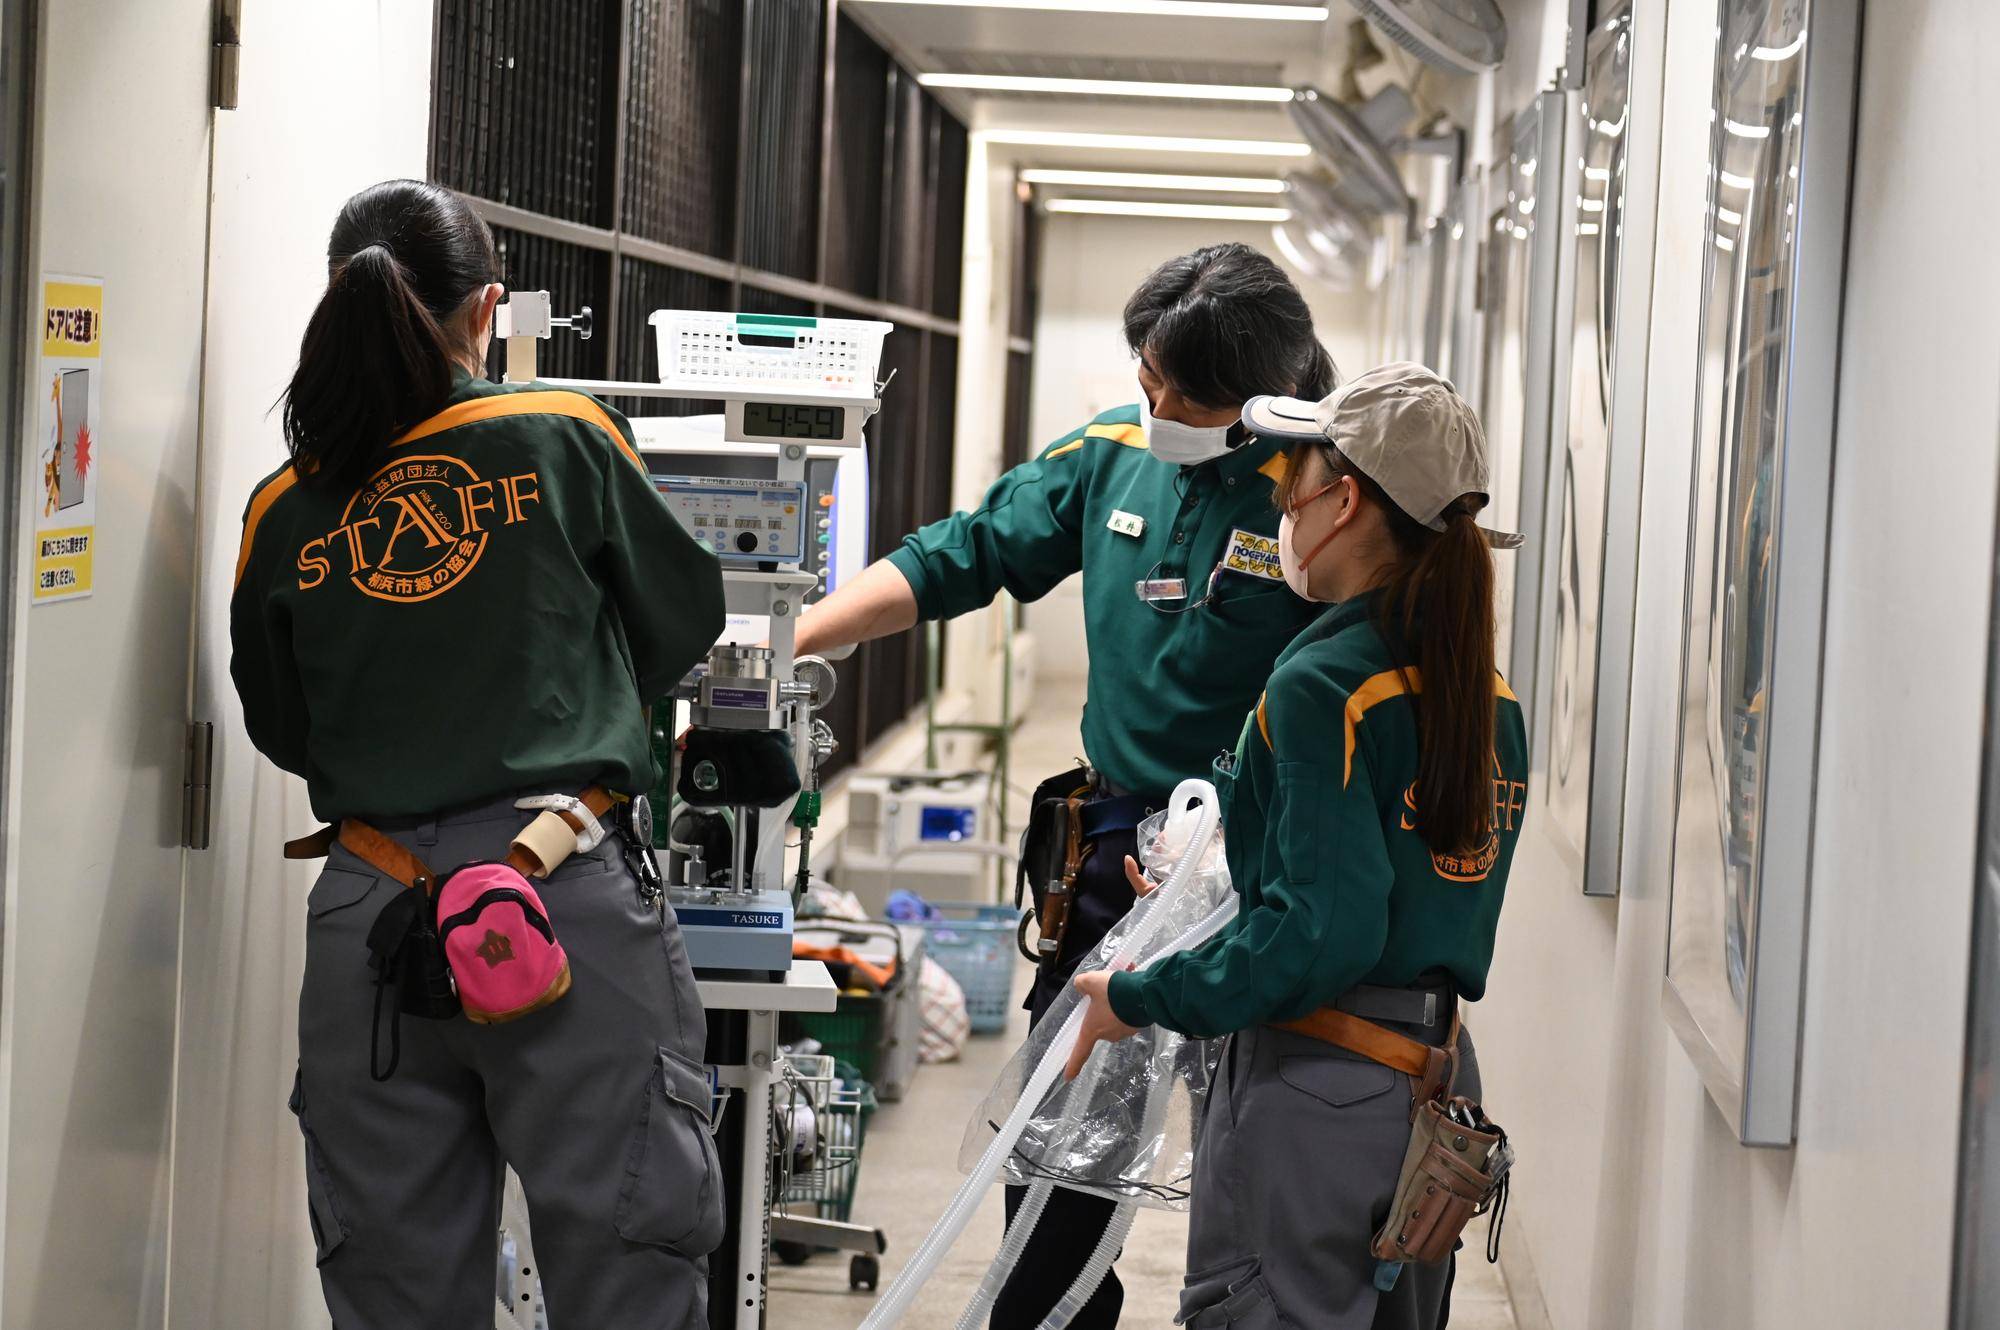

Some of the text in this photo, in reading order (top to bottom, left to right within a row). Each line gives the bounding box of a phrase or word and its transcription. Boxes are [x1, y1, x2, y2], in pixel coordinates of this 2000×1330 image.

[46, 307, 98, 343] ドアに注意！
[767, 405, 834, 438] 4:59
[362, 464, 450, 506] 公益財団法人
[296, 472, 541, 591] STAFF
[434, 510, 453, 530] ZOO
[367, 539, 477, 594] 横浜市緑の協会
[1232, 544, 1281, 566] NOGEYAM
[1400, 778, 1527, 832] SFF
[731, 914, 780, 925] TASUKE
